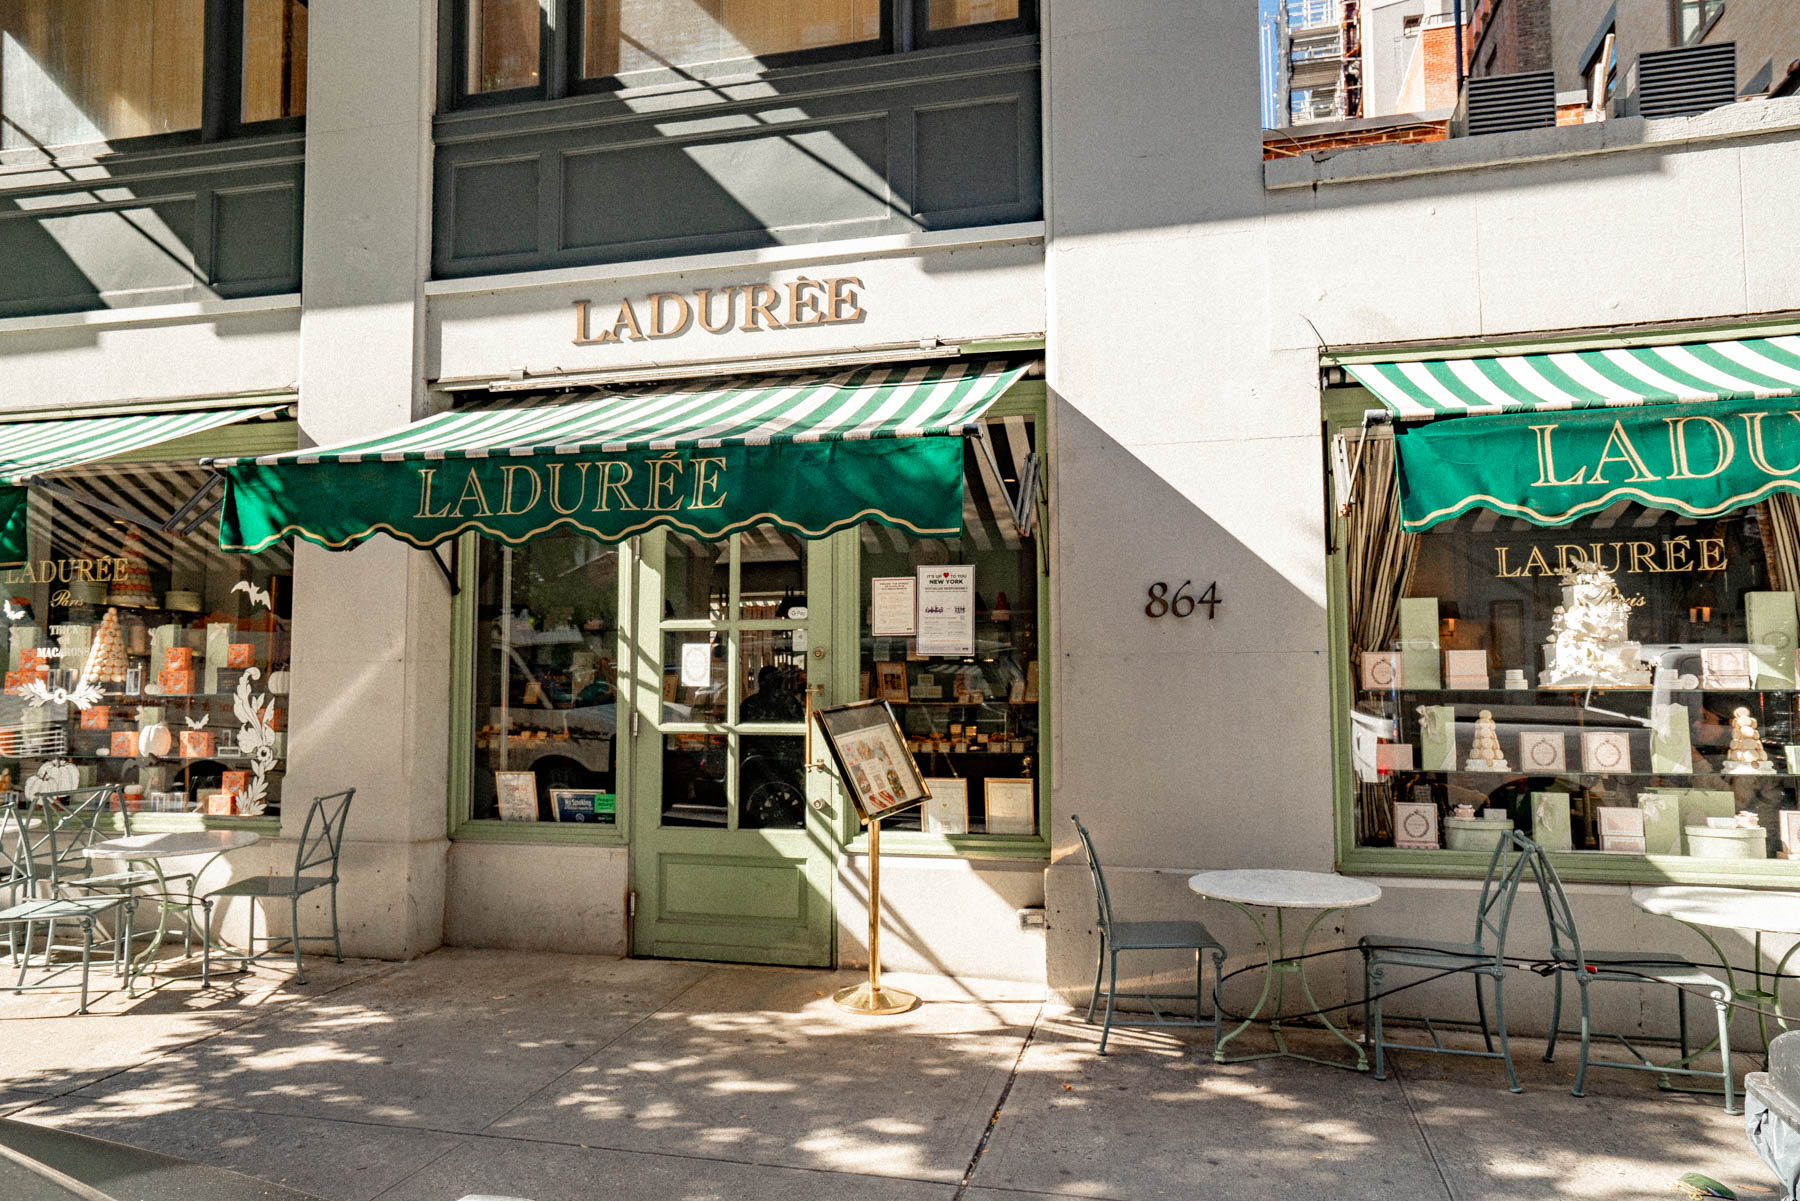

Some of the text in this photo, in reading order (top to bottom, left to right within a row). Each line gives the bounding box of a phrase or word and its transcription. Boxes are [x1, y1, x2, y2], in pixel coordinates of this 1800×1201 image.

[413, 451, 728, 518] LADURÉE
[5, 555, 129, 584] LADURÉE
[1495, 535, 1728, 578] LADURÉE
[50, 589, 84, 608] Paris
[1145, 580, 1222, 620] 864
[49, 624, 81, 636] TRICK
[36, 647, 90, 659] MACARONS
